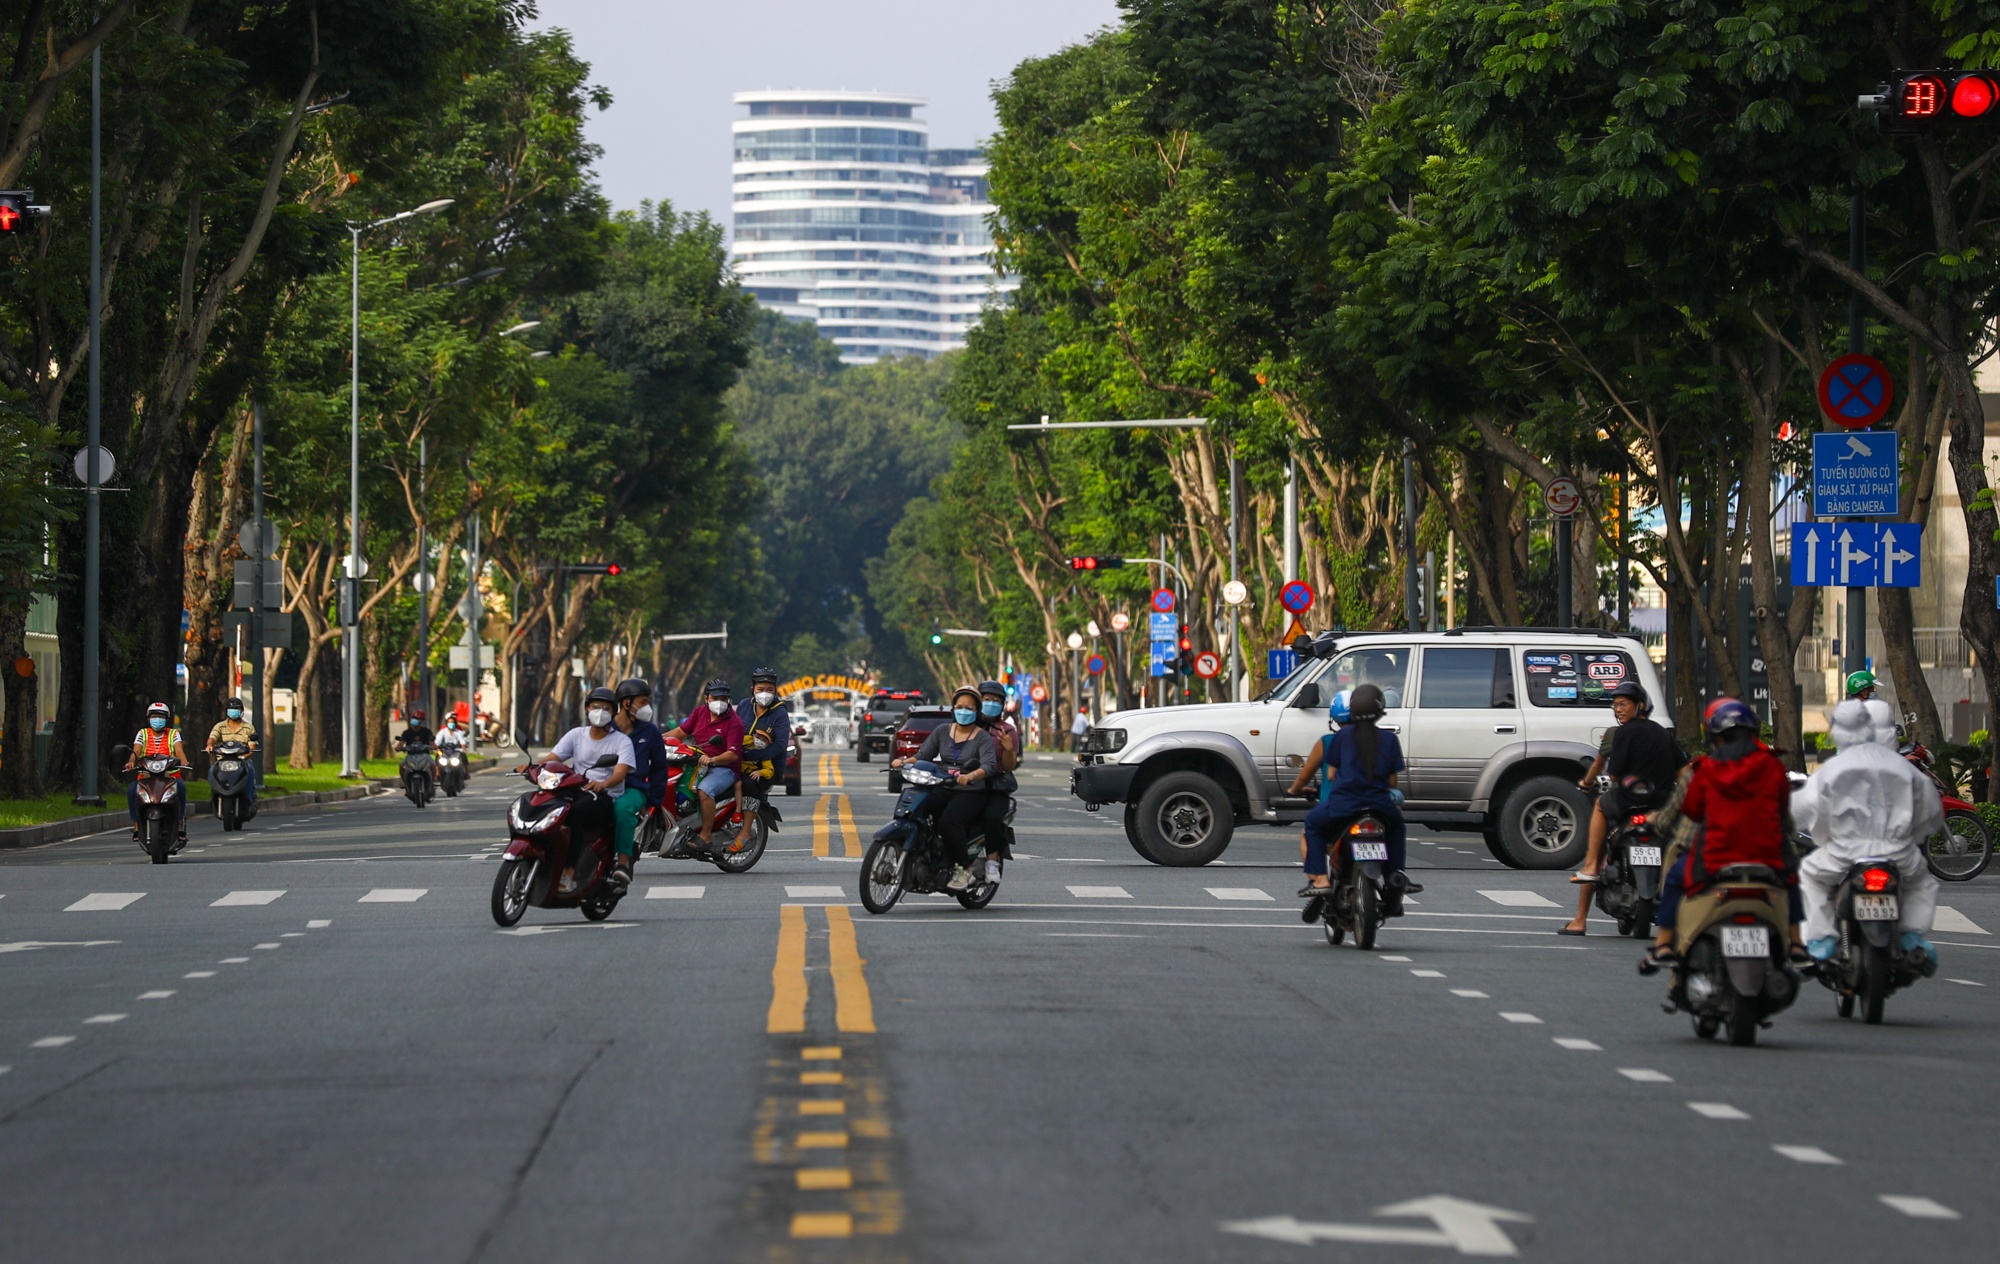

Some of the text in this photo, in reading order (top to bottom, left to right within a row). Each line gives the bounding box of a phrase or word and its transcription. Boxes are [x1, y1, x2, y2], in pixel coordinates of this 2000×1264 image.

[1906, 82, 1934, 114] 33
[1821, 464, 1890, 479] TUYẾN ĐƯỜNG CÓ
[1818, 481, 1838, 496] GIÁM
[1860, 480, 1870, 495] XỬ
[1872, 483, 1893, 497] PHẠT
[1828, 497, 1885, 513] BẰNG CAMERA
[1593, 666, 1620, 675] ARB
[1904, 712, 1917, 725] 23
[1634, 847, 1656, 856] 59-C1
